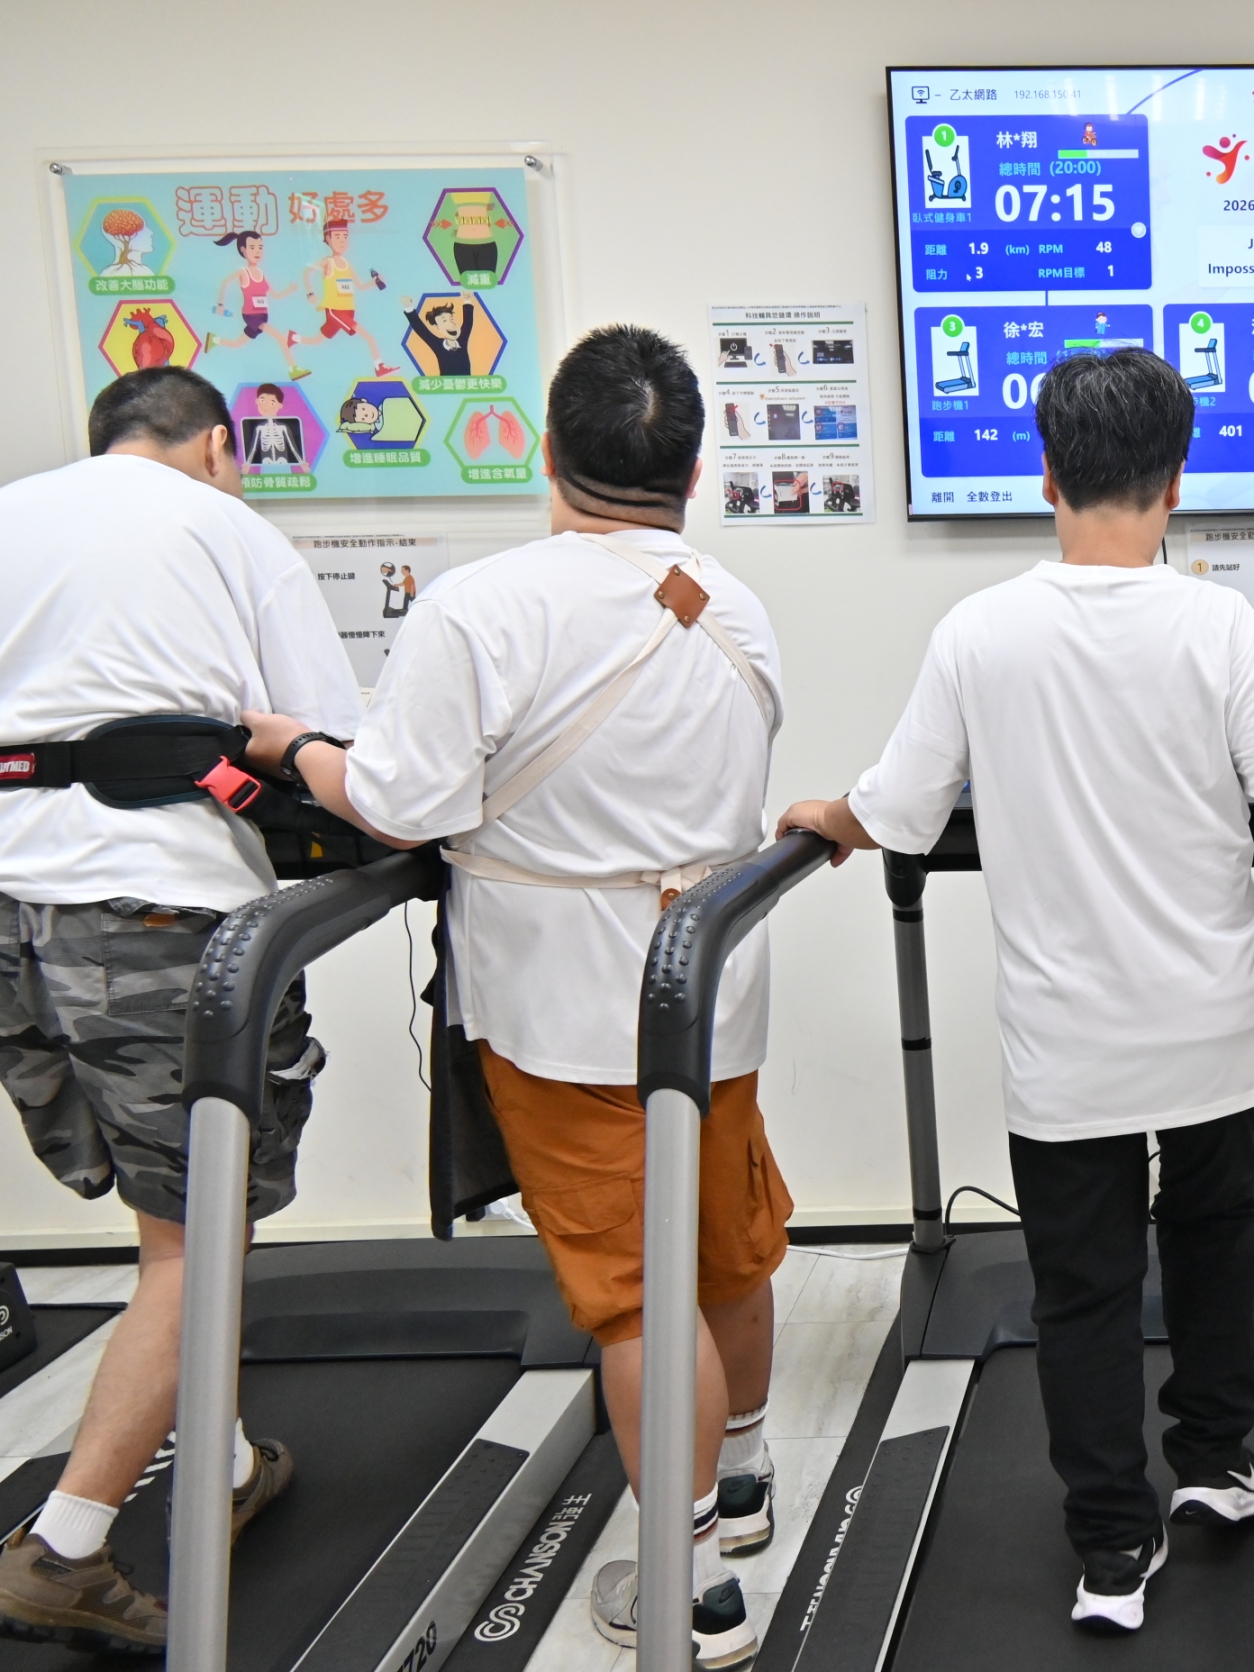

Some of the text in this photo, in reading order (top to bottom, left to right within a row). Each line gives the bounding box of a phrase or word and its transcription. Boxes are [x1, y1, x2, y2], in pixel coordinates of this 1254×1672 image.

[949, 89, 997, 101] 乙太網路
[942, 131, 947, 140] 1
[999, 160, 1101, 176] 總時間 (20:00)
[995, 184, 1115, 222] 07:15
[176, 185, 389, 237] 運動 好處多
[912, 212, 972, 224] 臥式健身車1
[925, 241, 1112, 256] 距離 1.9 (km) RPM 48
[467, 273, 491, 285] 減重
[926, 265, 1114, 281] 阻力 3 RPM目標 1
[95, 279, 168, 292] 改善大腦功能
[949, 322, 956, 331] 3
[1197, 319, 1204, 328] 4
[1006, 351, 1047, 366] 總時間
[931, 400, 969, 411] 跑步機1
[933, 429, 1030, 442] 距離 142 (m)
[1219, 425, 1242, 437] 401
[349, 451, 421, 463] 增進睡眠品質
[468, 468, 527, 479] 增進含氧量
[931, 491, 1012, 503] 離開 全數登出
[504, 1521, 575, 1601] CHANSON
